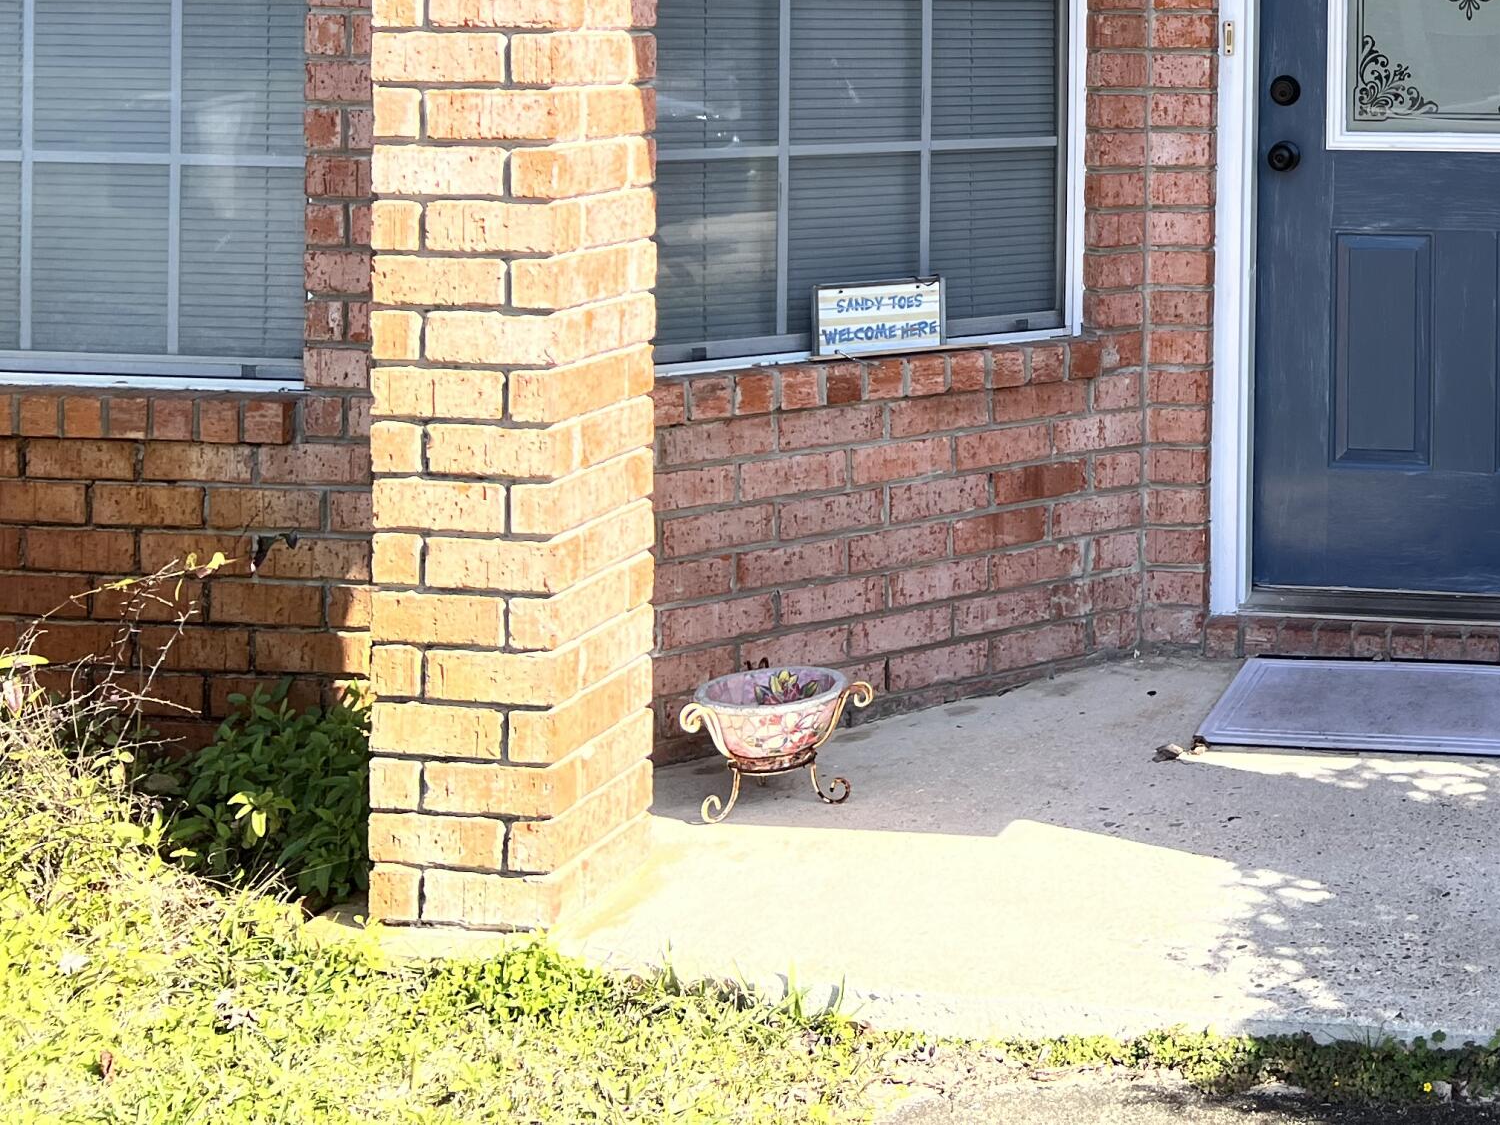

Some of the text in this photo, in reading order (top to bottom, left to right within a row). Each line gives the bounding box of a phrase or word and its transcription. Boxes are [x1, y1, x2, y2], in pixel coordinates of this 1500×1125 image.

[836, 293, 923, 313] SANDY TOES
[821, 320, 937, 345] WELCOME HERE
